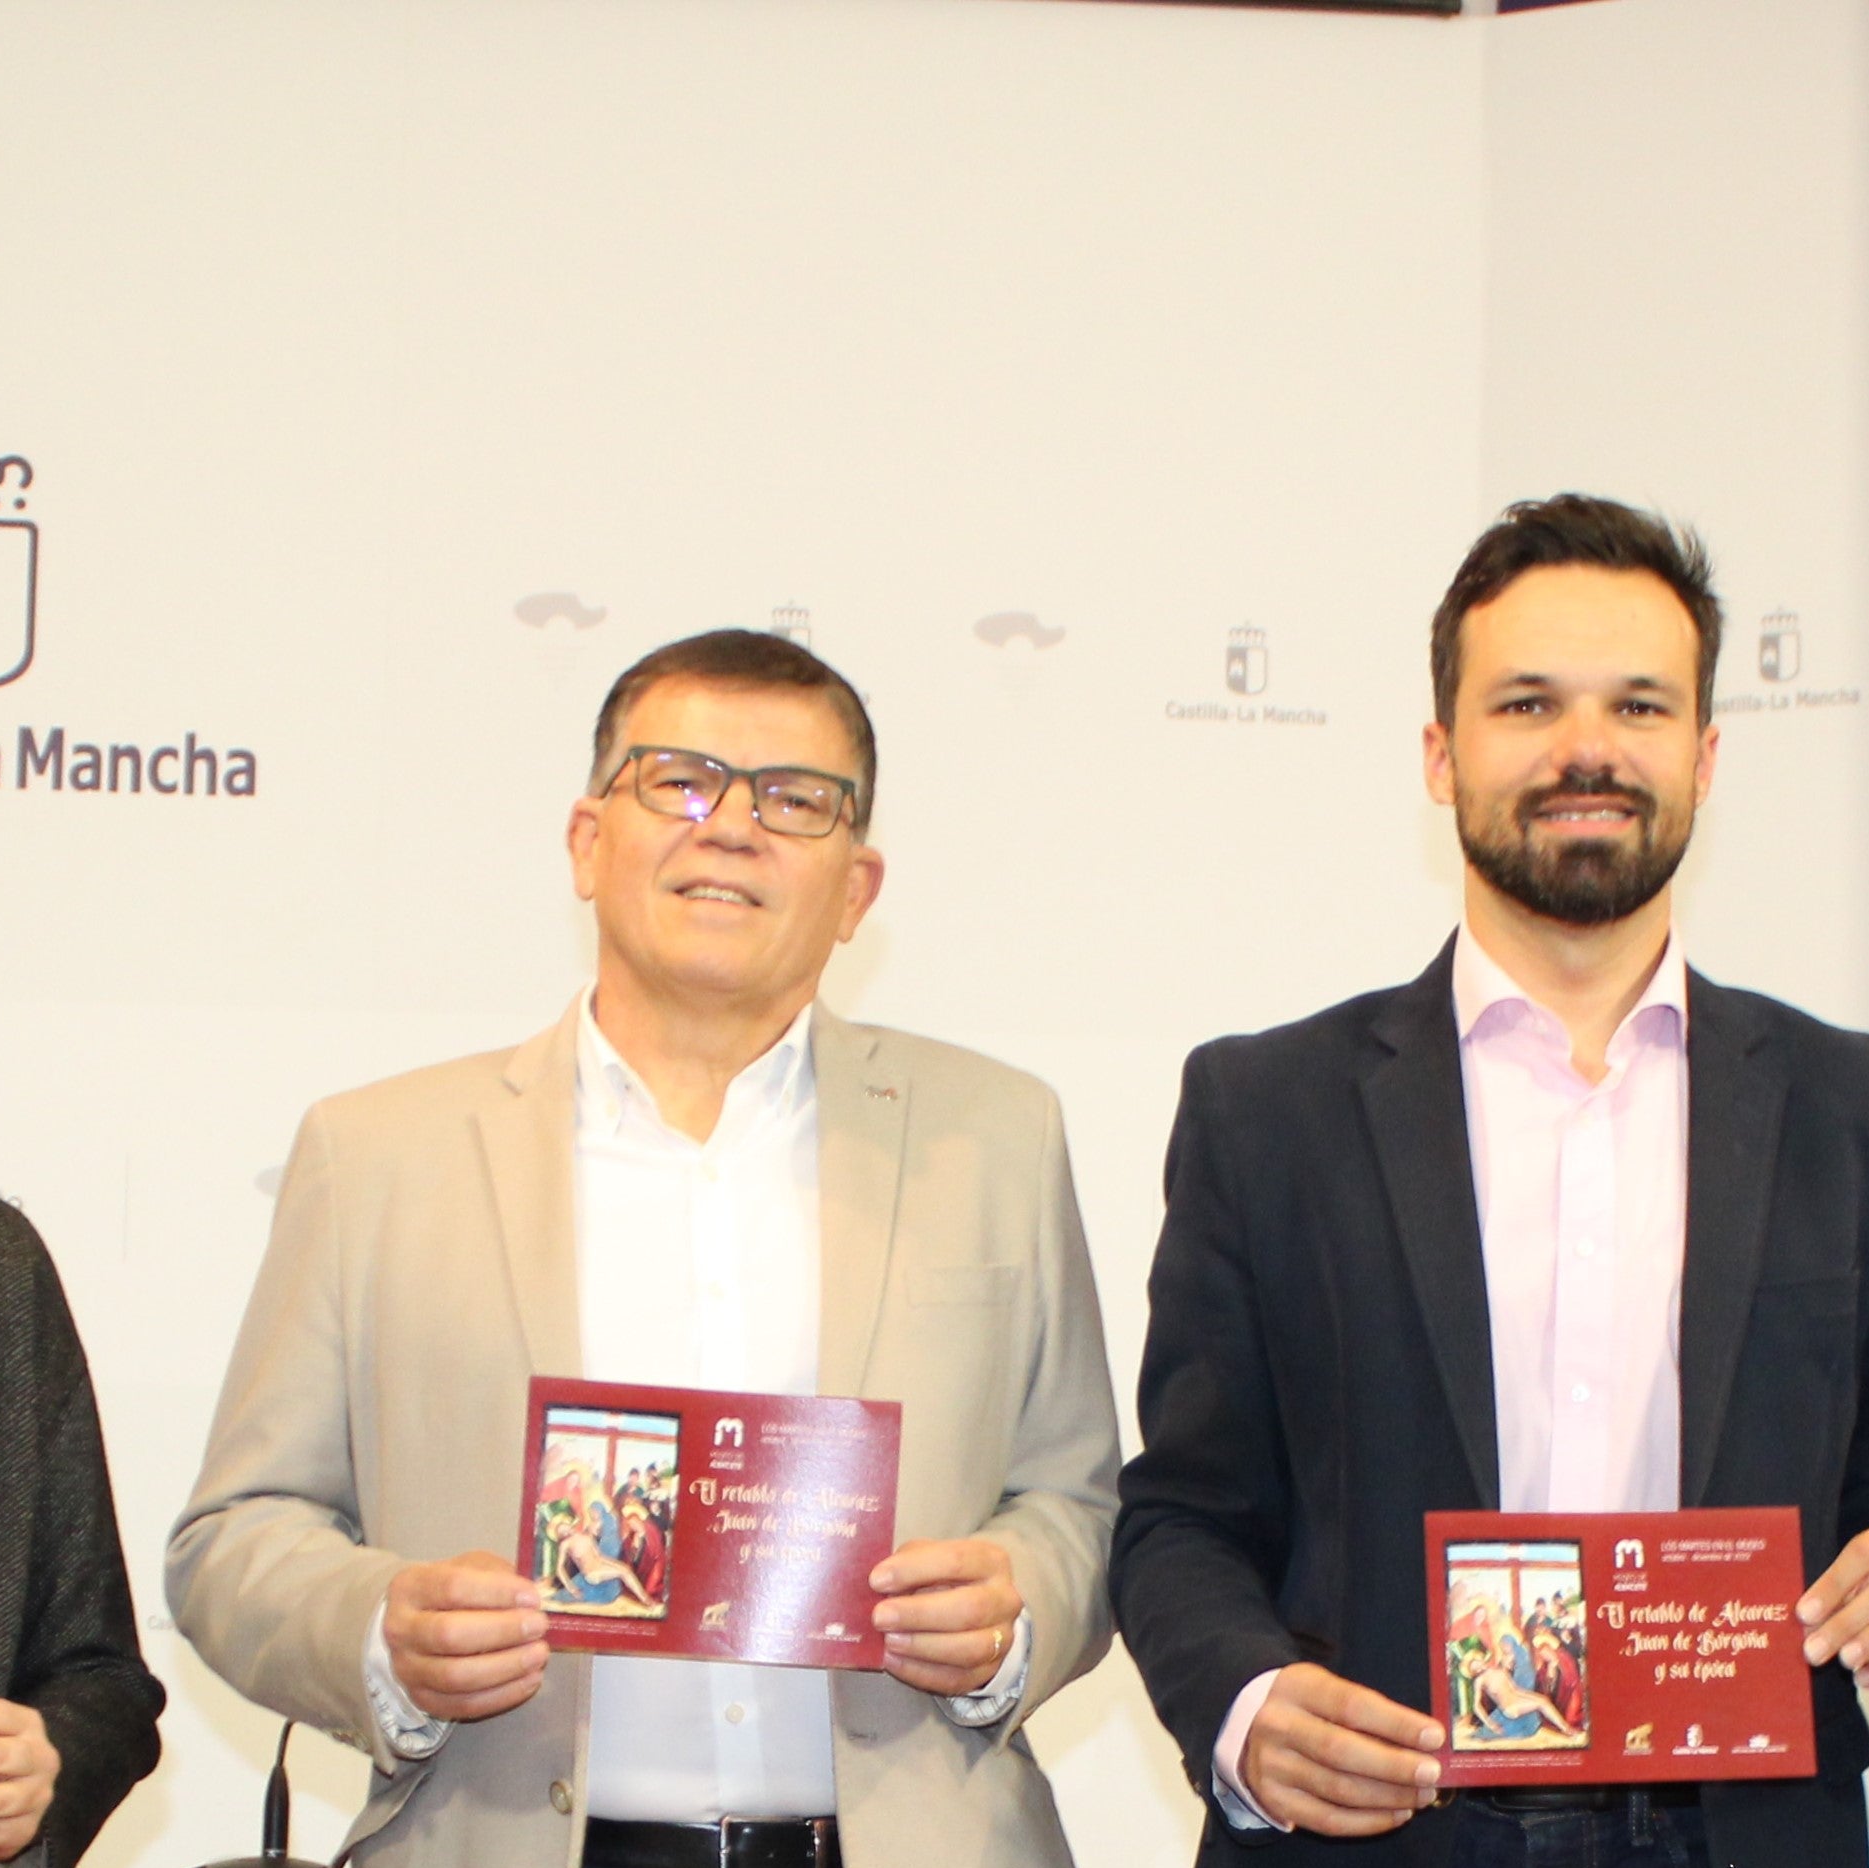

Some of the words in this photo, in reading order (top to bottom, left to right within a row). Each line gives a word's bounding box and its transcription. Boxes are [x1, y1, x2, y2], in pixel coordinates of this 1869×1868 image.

[1263, 704, 1327, 725] Mancha
[16, 726, 258, 797] Mancha
[1597, 1601, 1625, 1629] El
[1630, 1601, 1685, 1625] retablo
[1688, 1602, 1708, 1624] de
[1619, 1631, 1669, 1657] Juan
[1672, 1630, 1692, 1651] de
[1696, 1629, 1769, 1656] Borgoña
[1654, 1662, 1667, 1685] y
[1669, 1661, 1690, 1680] su
